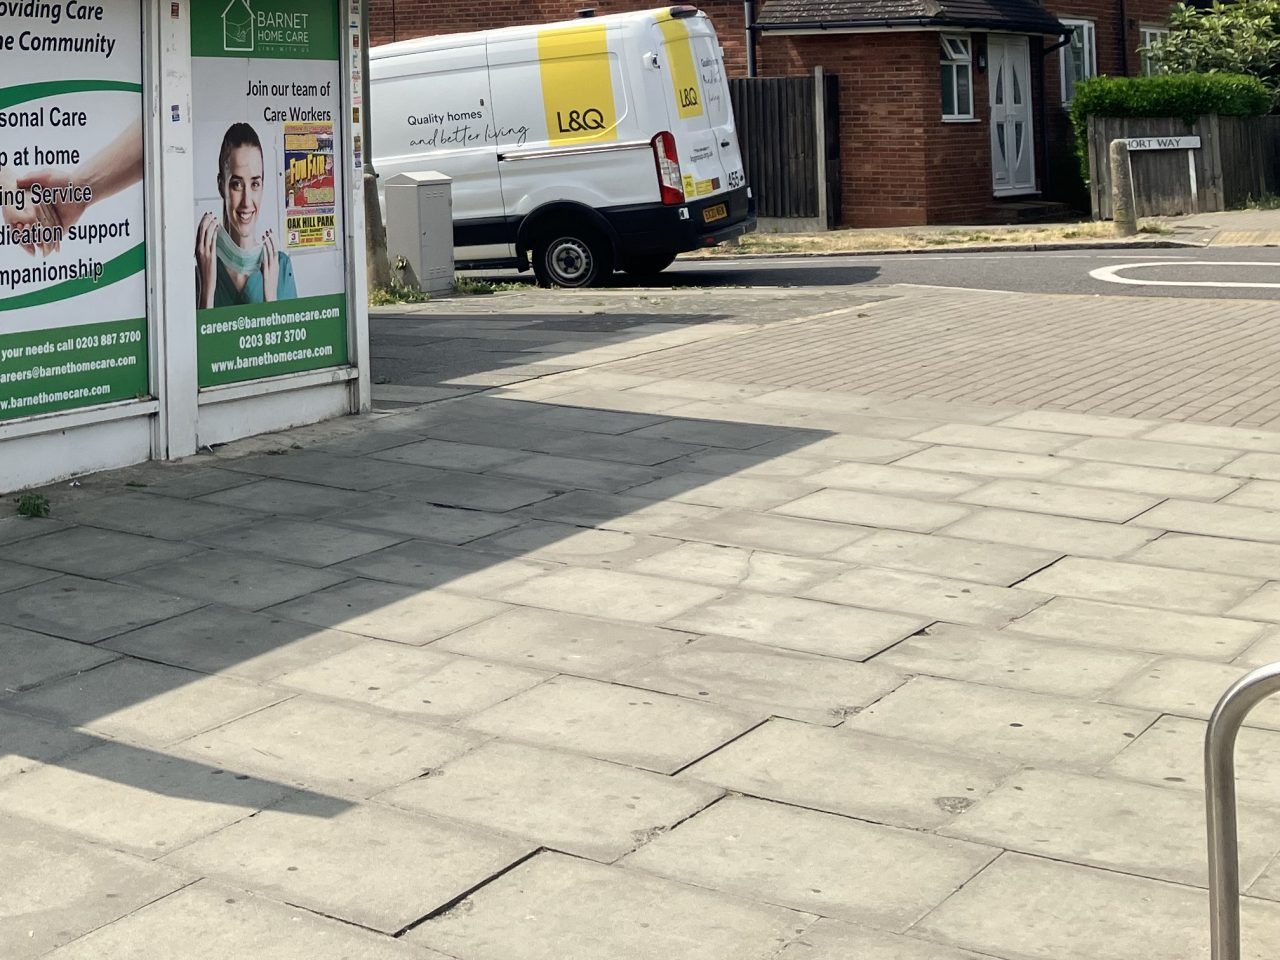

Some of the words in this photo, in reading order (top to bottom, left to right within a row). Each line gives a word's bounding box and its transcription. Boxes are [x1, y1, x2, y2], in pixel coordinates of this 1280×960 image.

[66, 0, 104, 21] Care
[257, 11, 309, 29] BARNET
[18, 30, 116, 59] Community
[257, 29, 283, 42] HOME
[285, 30, 309, 43] CARE
[246, 80, 269, 97] Join
[271, 84, 289, 97] our
[291, 83, 318, 97] team
[320, 81, 331, 97] of
[679, 87, 698, 108] L&Q
[49, 106, 87, 127] Care
[263, 106, 287, 122] Care
[289, 107, 331, 122] Workers
[407, 114, 444, 126] Quality
[447, 110, 482, 122] homes
[557, 108, 606, 133] L&Q
[410, 128, 439, 147] and
[440, 124, 480, 145] better
[484, 123, 529, 148] living
[1127, 139, 1153, 149] HORT
[1157, 138, 1181, 148] WAY
[13, 147, 29, 166] at
[34, 145, 80, 166] home
[290, 157, 307, 185] FUN
[307, 153, 325, 180] FAIR
[30, 183, 92, 205] Service
[68, 218, 131, 244] support
[287, 217, 302, 230] OAK
[302, 216, 317, 228] HILL
[317, 214, 335, 227] PARK
[290, 233, 297, 241] 3
[200, 306, 340, 335] careers@barnethomecare.com
[1, 345, 23, 362] your
[25, 342, 55, 356] needs
[56, 339, 73, 353] call
[75, 336, 99, 350] 0203
[100, 333, 117, 346] 887
[119, 330, 141, 344] 3700
[239, 334, 263, 349] 0203
[264, 331, 281, 346] 887
[284, 328, 307, 343] 3700
[211, 344, 333, 373] www.barnethomecare.com
